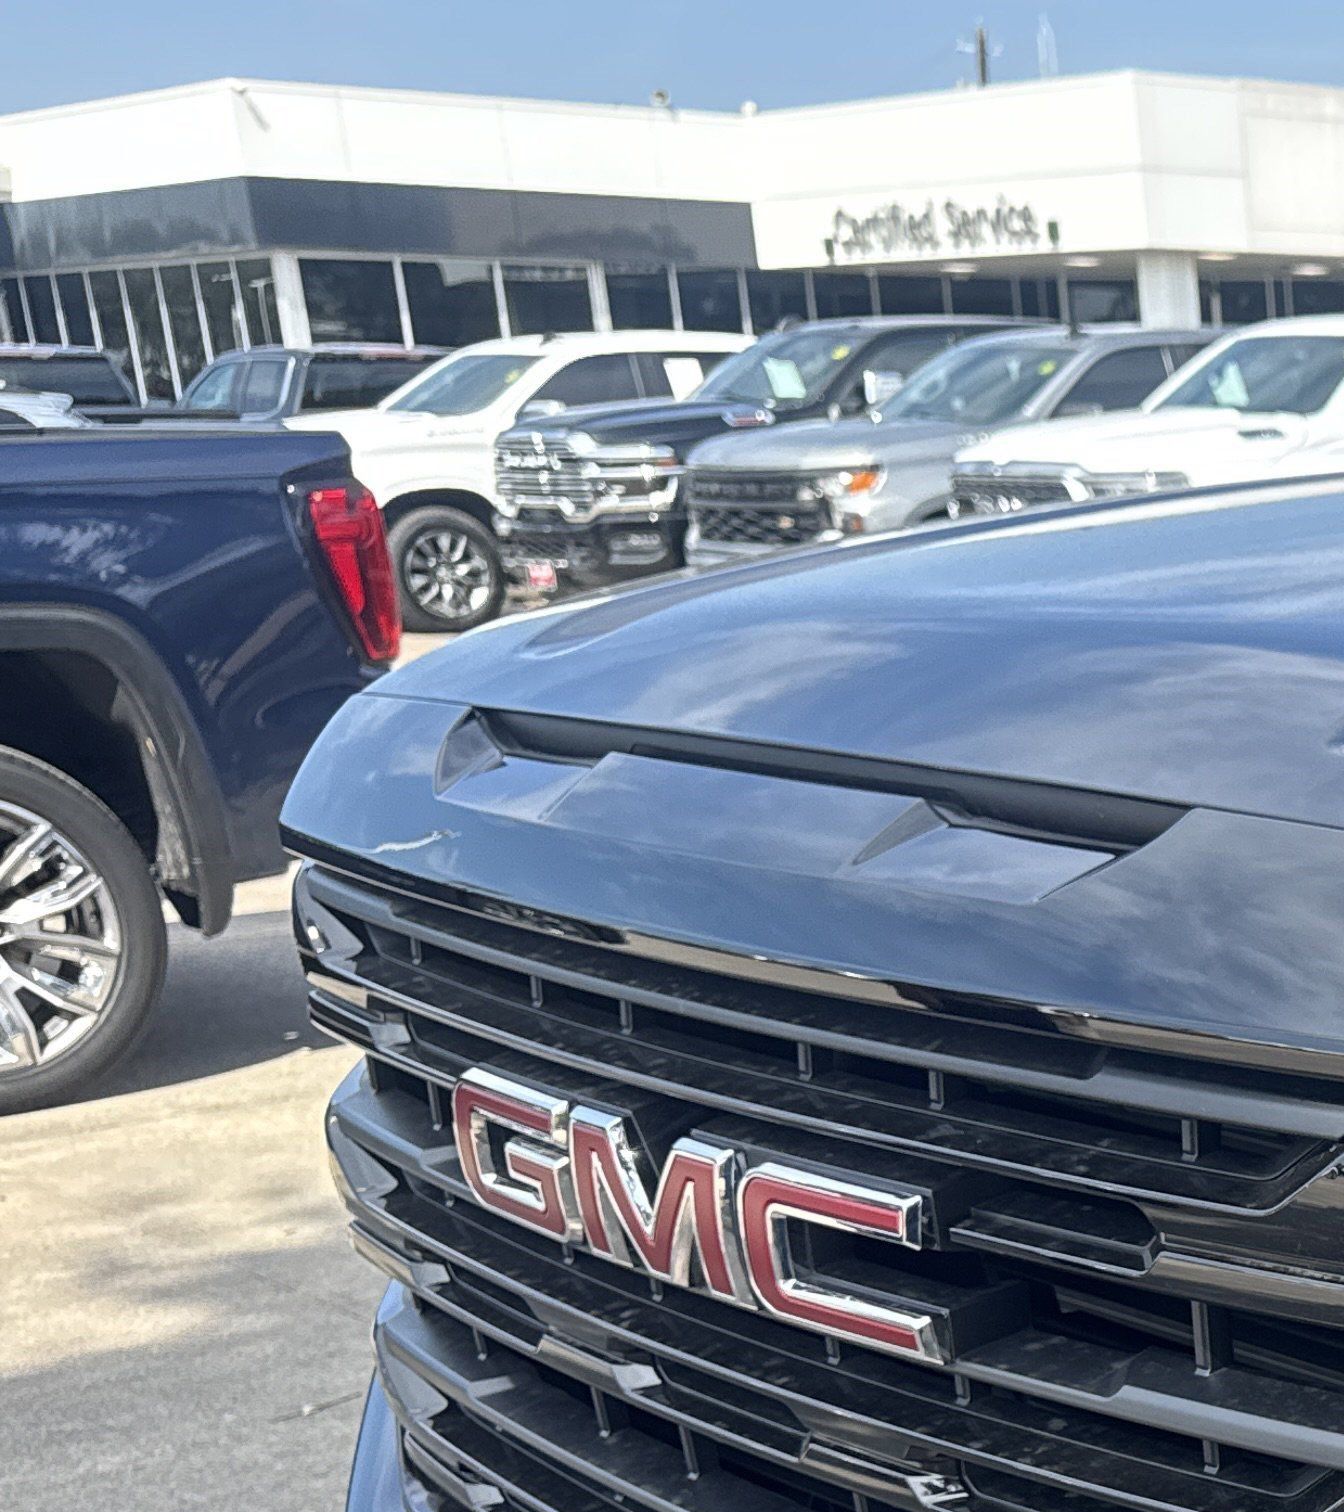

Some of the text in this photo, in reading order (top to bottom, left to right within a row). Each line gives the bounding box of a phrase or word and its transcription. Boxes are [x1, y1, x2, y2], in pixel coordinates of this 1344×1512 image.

[834, 194, 1040, 256] Certified Service
[453, 1067, 948, 1365] GMC
